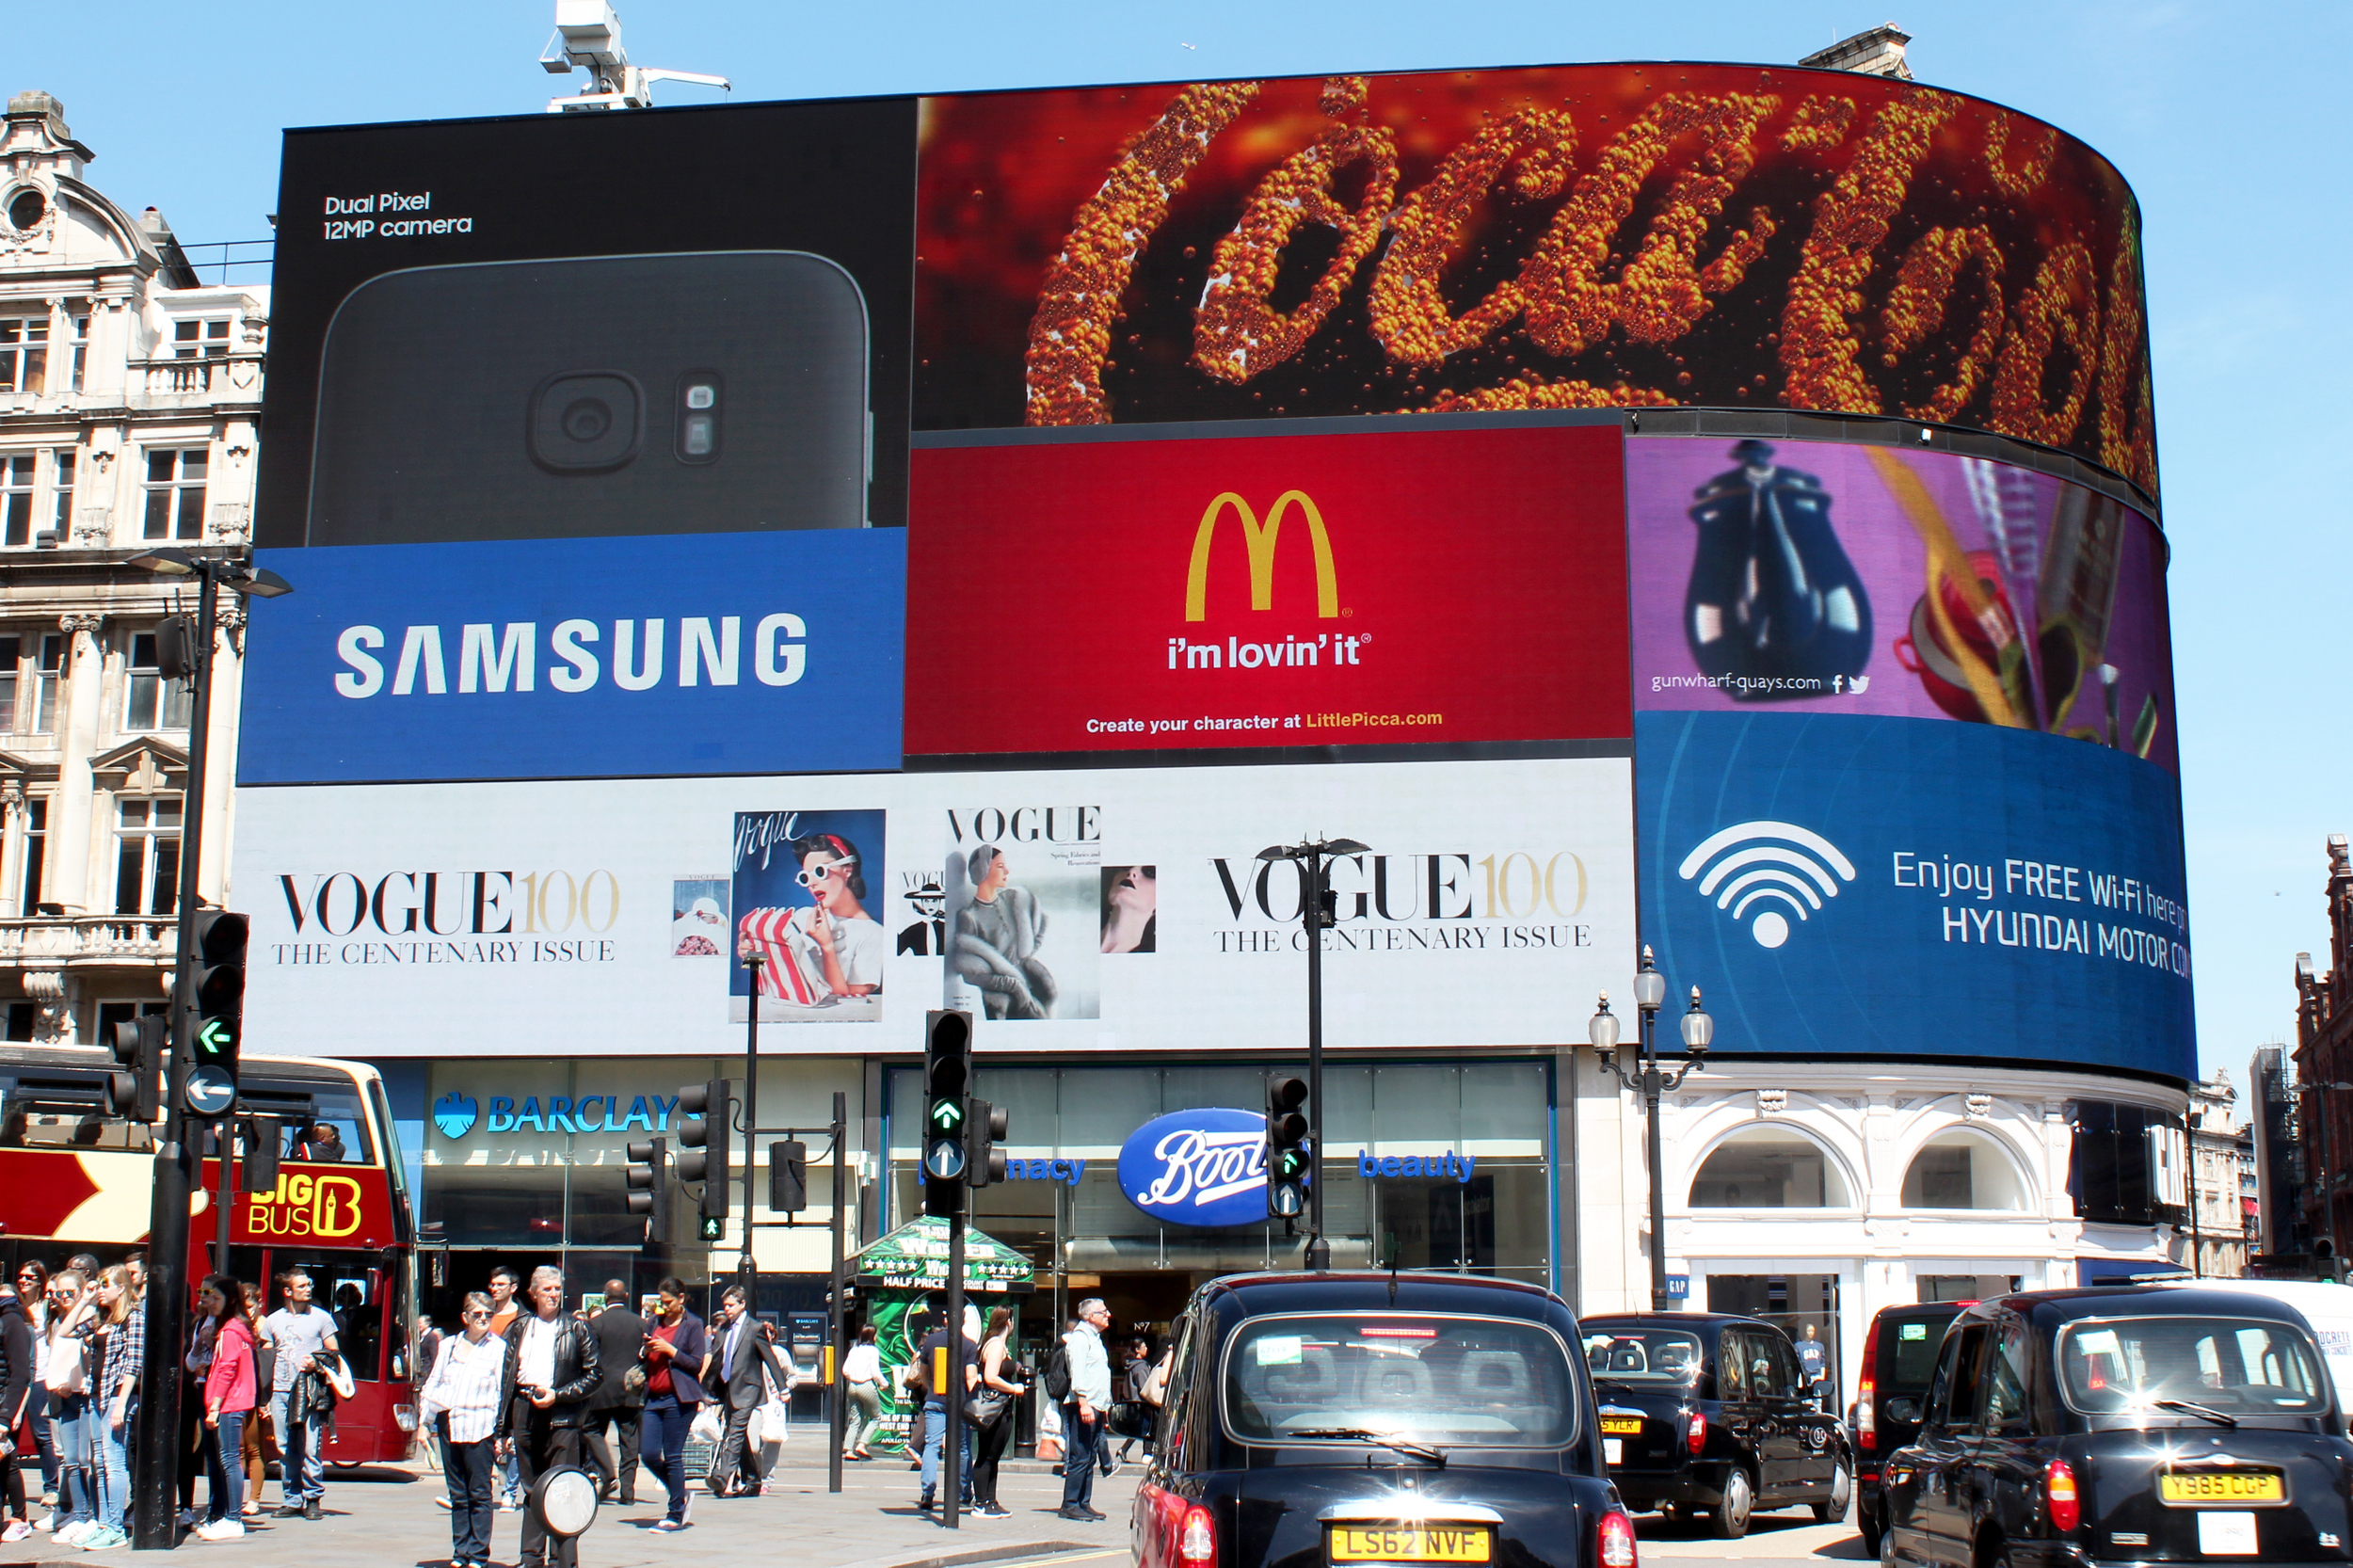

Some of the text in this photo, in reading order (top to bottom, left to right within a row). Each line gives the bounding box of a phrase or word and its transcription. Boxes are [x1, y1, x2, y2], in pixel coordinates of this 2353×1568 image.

[325, 191, 430, 216] Dual Pixel
[324, 217, 472, 240] 12MP camera
[334, 613, 808, 699] SAMSUNG
[1168, 637, 1221, 669] i'm
[1228, 634, 1327, 668] lovin'
[1651, 672, 1821, 693] gunwharf-quays.com
[1086, 712, 1443, 734] Create your character at LittlePicca.com
[947, 806, 1100, 844] VOGUE
[1050, 851, 1069, 859] Spring
[1894, 851, 1993, 901] Enjoy
[2005, 858, 2081, 903] FREE
[2088, 871, 2142, 914] Wi-Fi
[2146, 885, 2176, 925] here
[1213, 929, 1281, 952] THE
[1500, 923, 1593, 949] ISSUE
[1942, 906, 2089, 954] HYUNDAI
[2097, 923, 2169, 970] MOTOR
[271, 939, 616, 965] THE CENTENARY ISSUE
[487, 1095, 701, 1133] BARCLAY
[1137, 1128, 1268, 1207] Boot
[1358, 1148, 1476, 1184] beauty
[248, 1205, 311, 1236] BUS
[883, 1276, 912, 1288] HALF
[914, 1277, 946, 1289] PRICE
[1669, 1280, 1686, 1293] GAP
[1803, 1349, 1819, 1360] GAP
[896, 1422, 909, 1431] END
[1346, 1530, 1476, 1555] LS62 NVF
